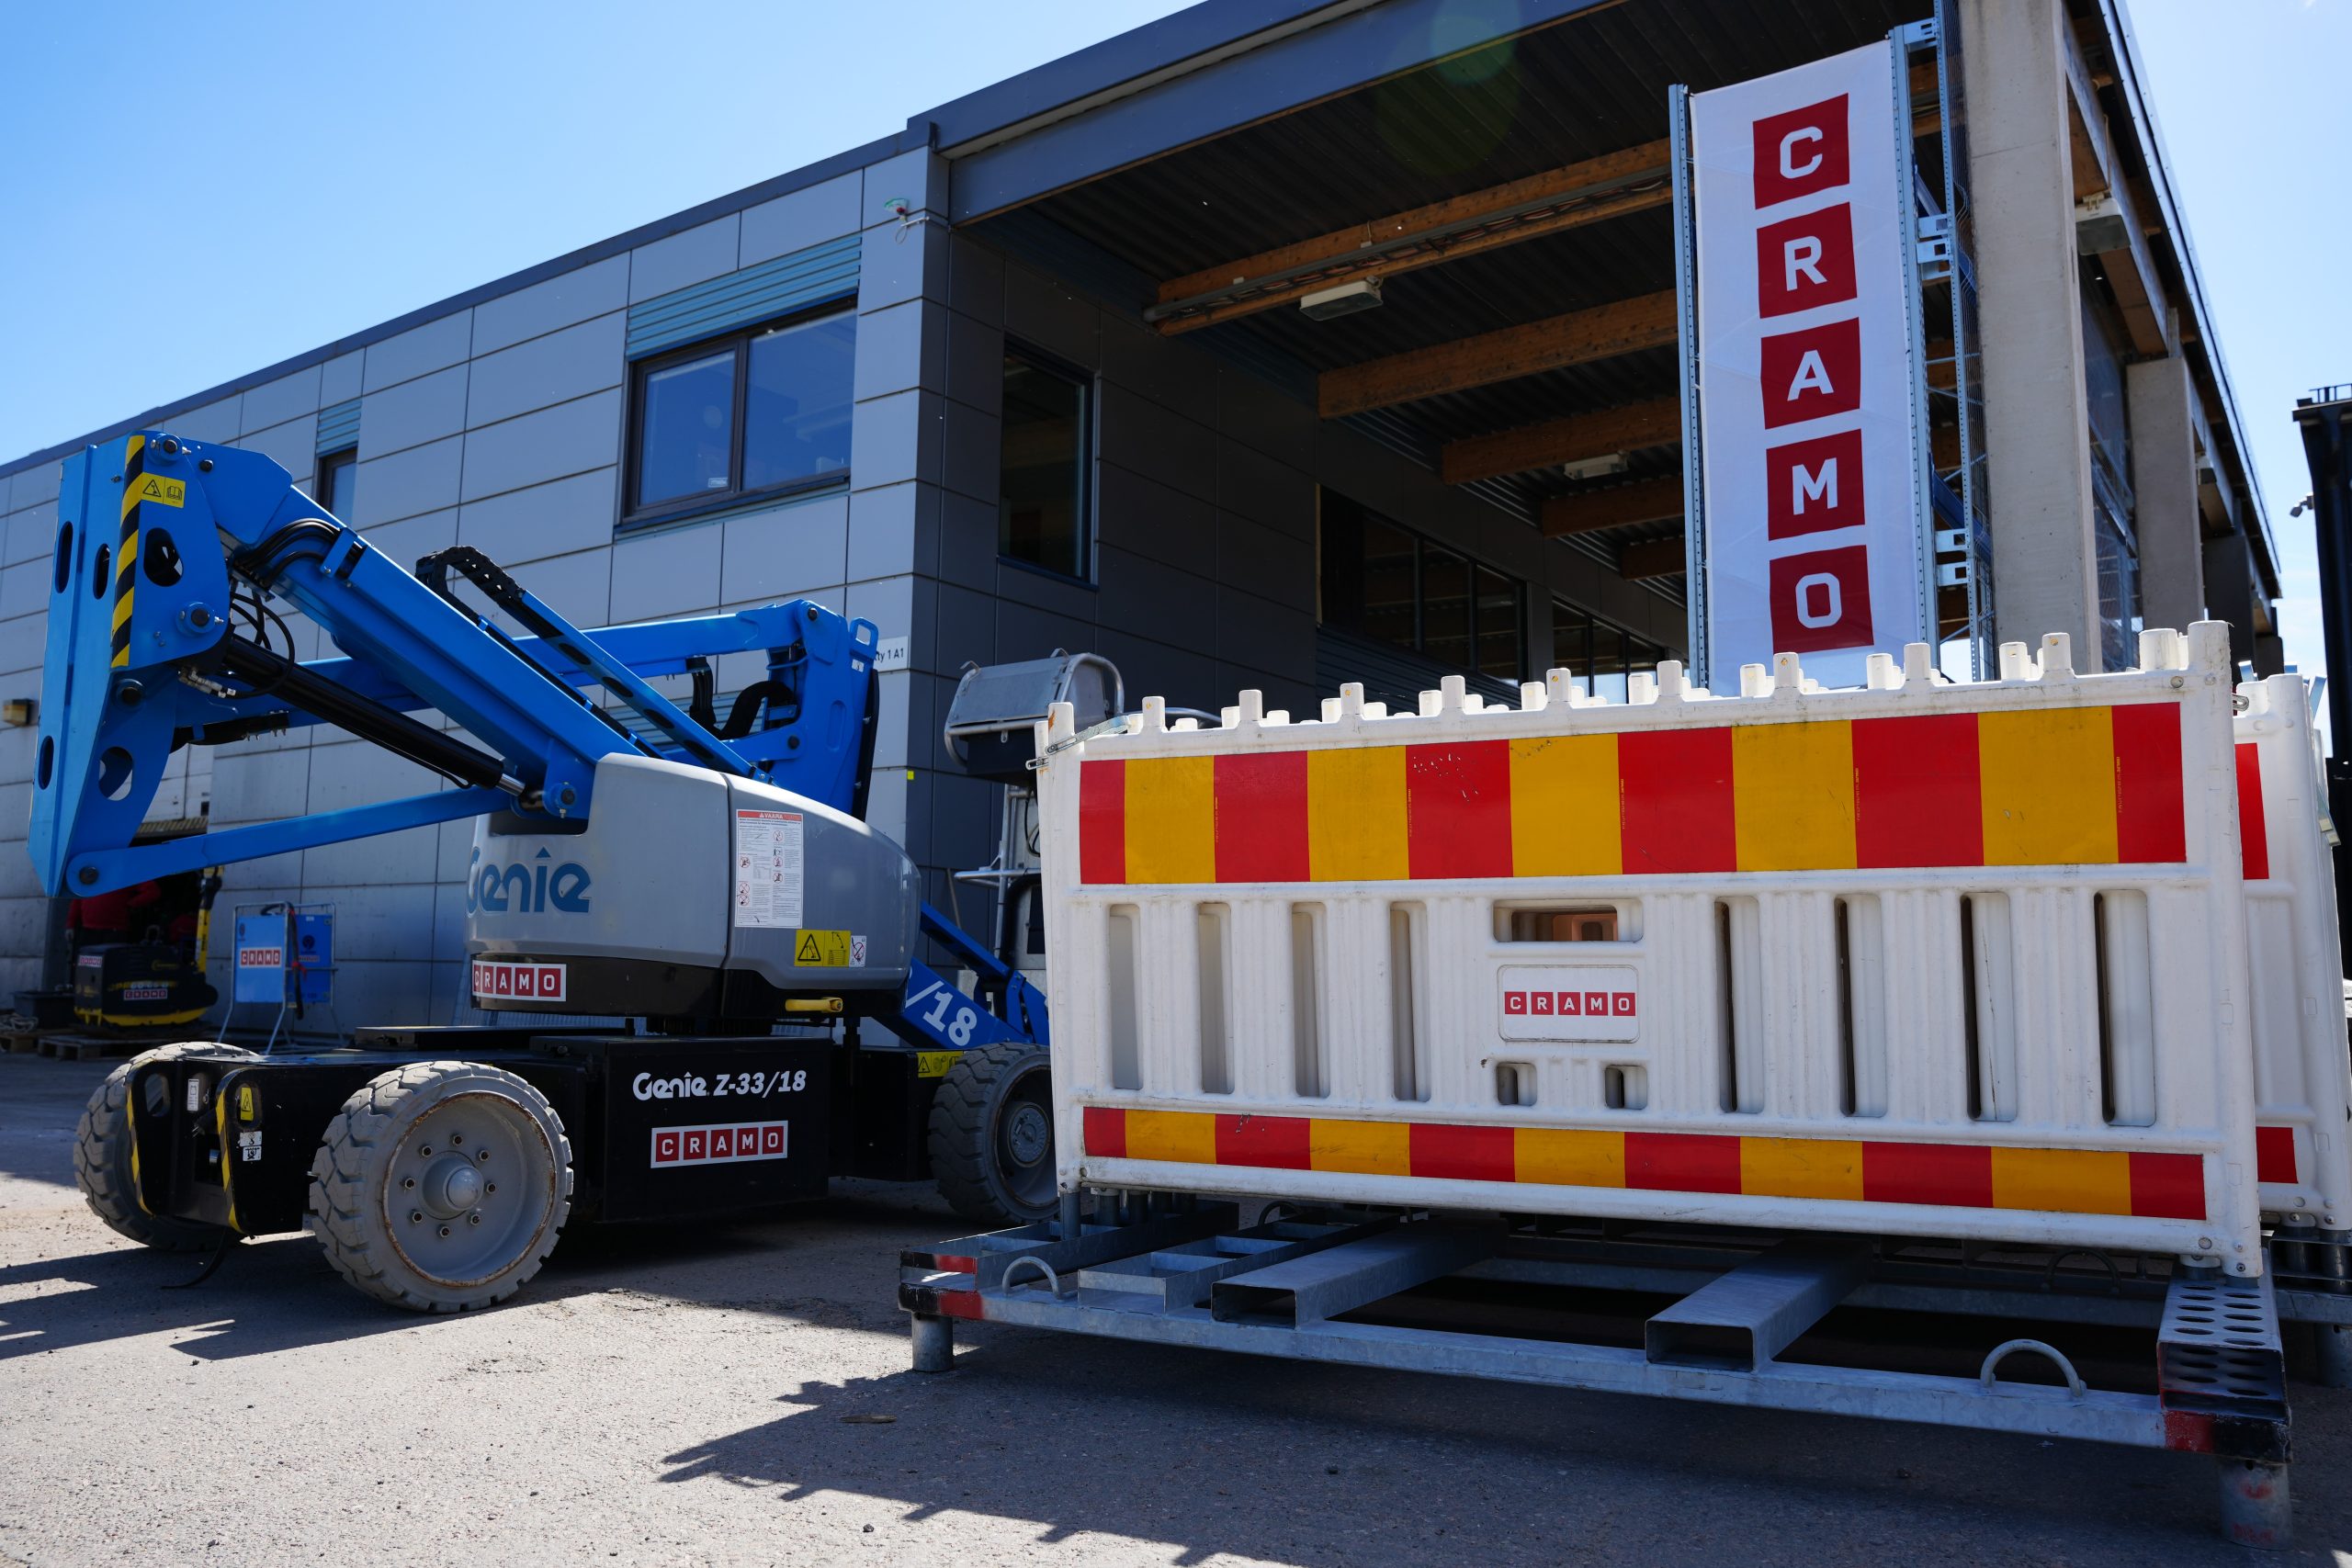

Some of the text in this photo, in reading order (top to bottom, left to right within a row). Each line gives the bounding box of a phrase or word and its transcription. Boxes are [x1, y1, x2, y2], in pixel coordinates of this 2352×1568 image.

[1779, 125, 1843, 630] CRAMO
[894, 648, 904, 659] A1
[241, 951, 280, 964] CRAMO
[474, 969, 556, 992] CRAMO
[905, 966, 978, 1046] /18
[1509, 995, 1631, 1012] CRAMO
[632, 1069, 807, 1100] Genie Z-33/18
[661, 1131, 780, 1156] CRAMO
